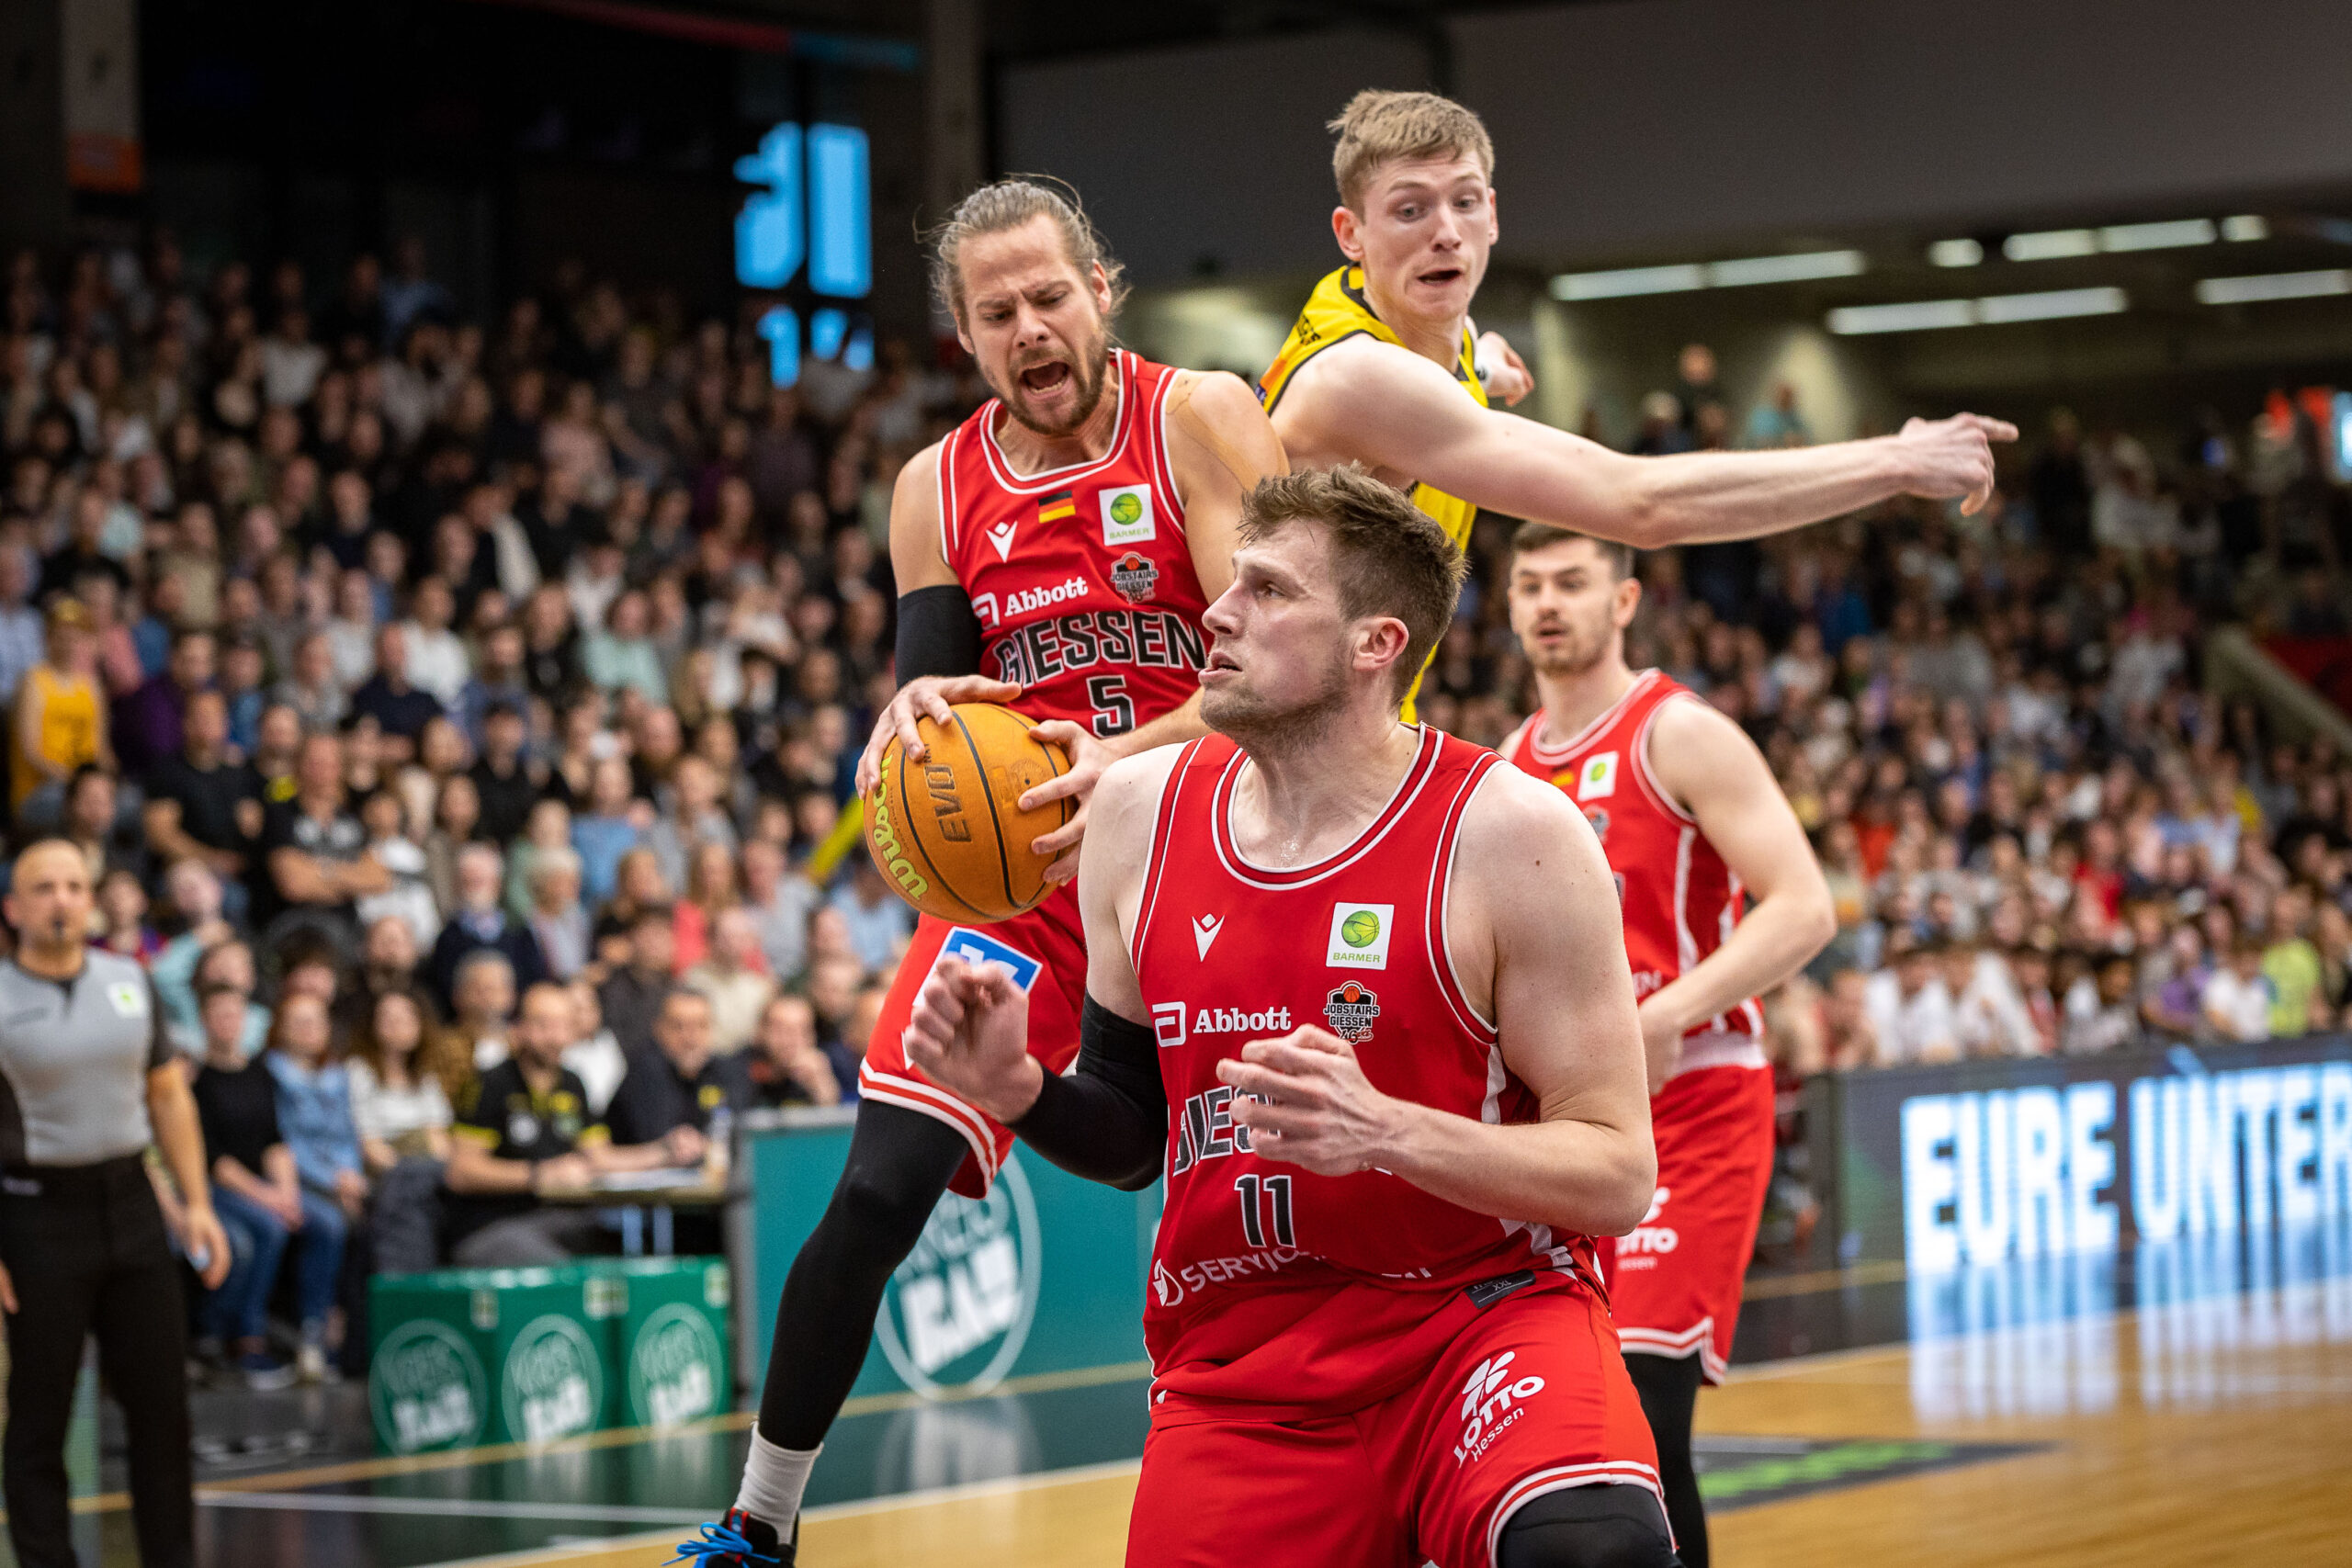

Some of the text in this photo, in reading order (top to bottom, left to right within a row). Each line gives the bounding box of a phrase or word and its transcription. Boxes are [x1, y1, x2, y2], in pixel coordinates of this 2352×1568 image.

[1109, 527, 1149, 539] BARMER
[1004, 576, 1089, 617] Abbott
[1110, 570, 1158, 582] JOBSTAIRS
[992, 610, 1207, 690] GIESSEN
[1086, 674, 1136, 738] 5
[924, 763, 972, 842] EVO
[1333, 952, 1381, 964] BARMER
[1193, 1006, 1292, 1034] Abbott
[1323, 1004, 1380, 1017] JOBSTAIRS
[1329, 1015, 1372, 1028] GIESSEN
[1900, 1079, 2120, 1274] EURE
[1234, 1173, 1296, 1248] 11
[1471, 1407, 1525, 1463] Hessen
